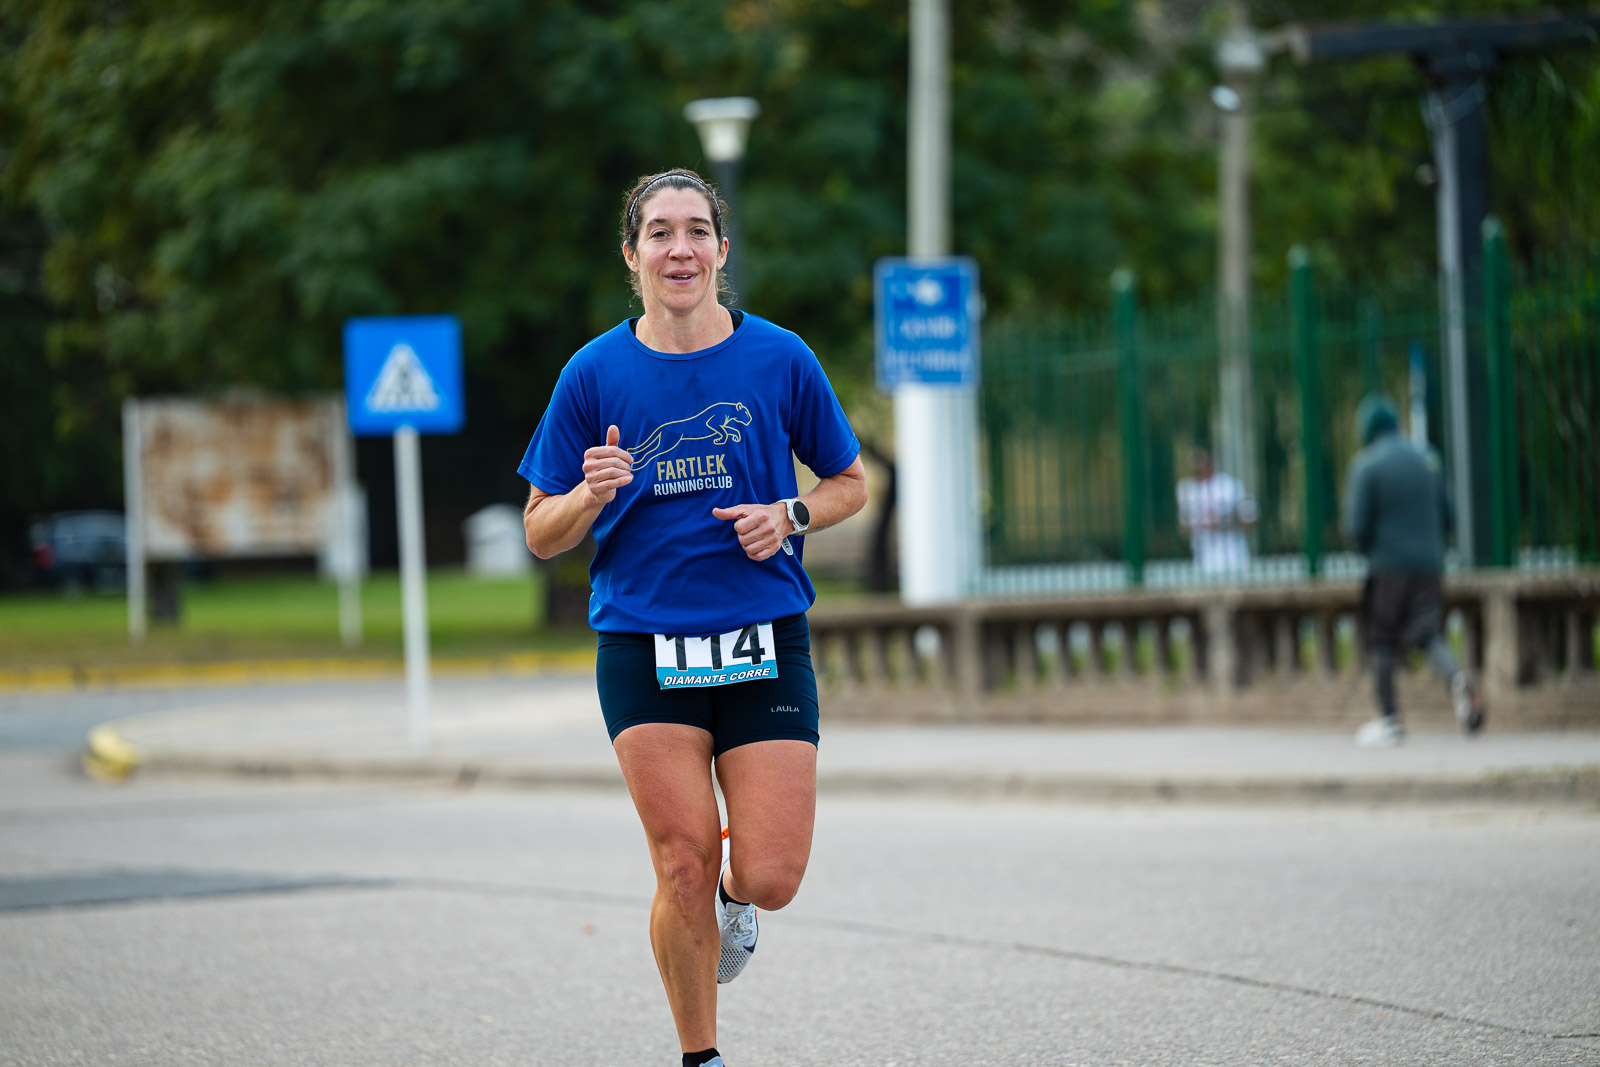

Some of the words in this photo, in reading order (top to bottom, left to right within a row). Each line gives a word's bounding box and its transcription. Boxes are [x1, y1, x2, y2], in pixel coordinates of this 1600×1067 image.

[656, 453, 727, 481] FARTLEK
[653, 478, 704, 496] RUNNING
[704, 475, 733, 489] CLUB
[664, 623, 766, 671] 114
[663, 674, 727, 686] DIAMANTE
[729, 667, 771, 681] CORRE
